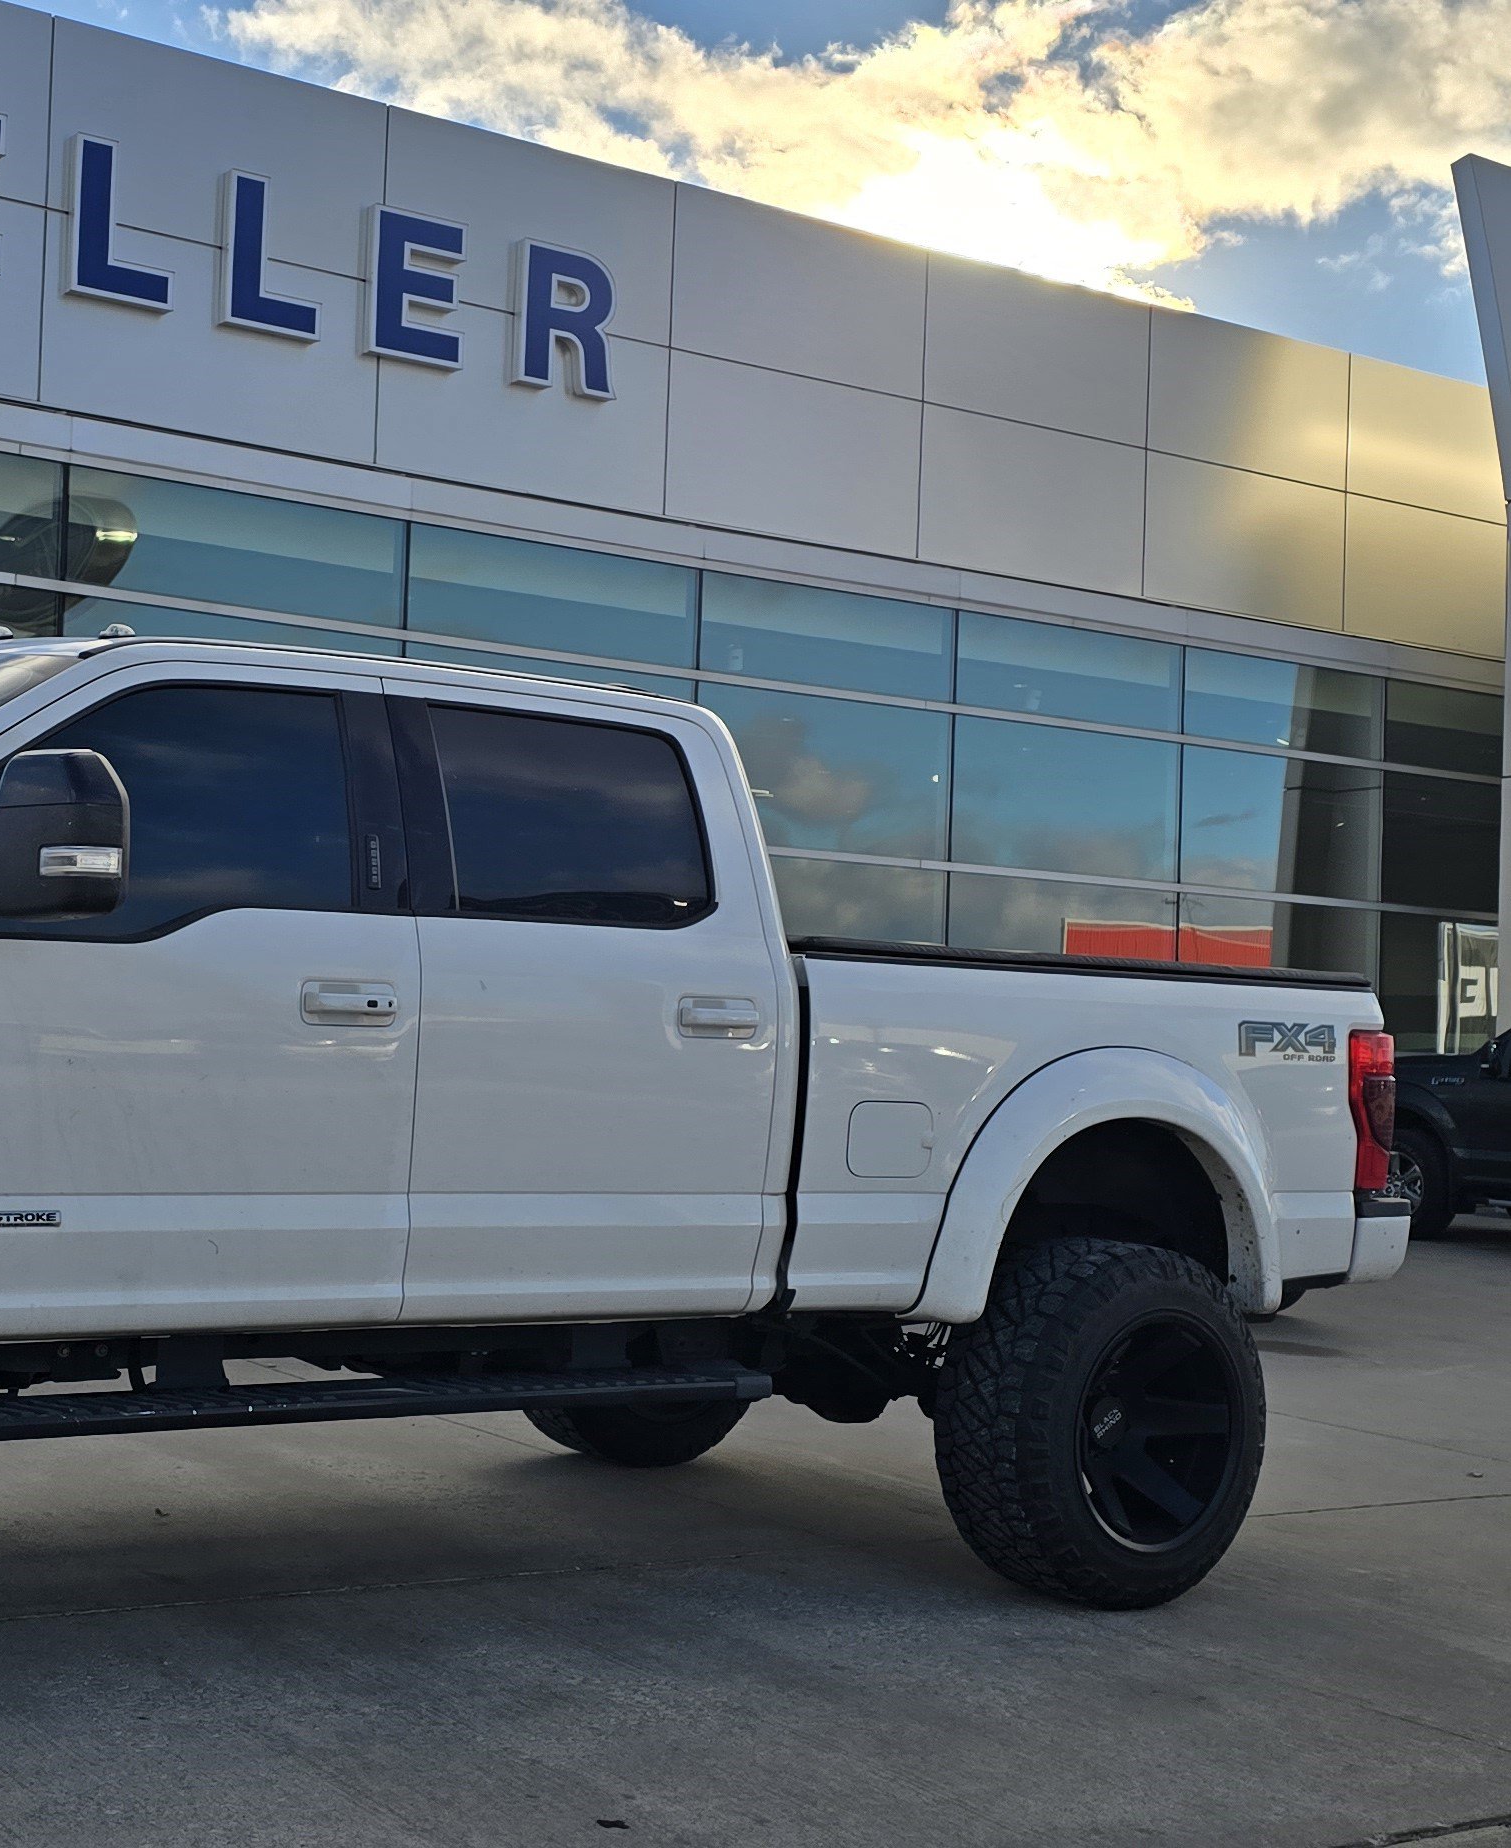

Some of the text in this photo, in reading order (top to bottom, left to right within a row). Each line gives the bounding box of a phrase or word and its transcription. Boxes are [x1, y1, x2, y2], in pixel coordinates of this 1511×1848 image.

[1238, 1020, 1336, 1057] FX4
[1282, 1053, 1337, 1063] OFF ROAD
[1093, 1408, 1120, 1434] BLACK
